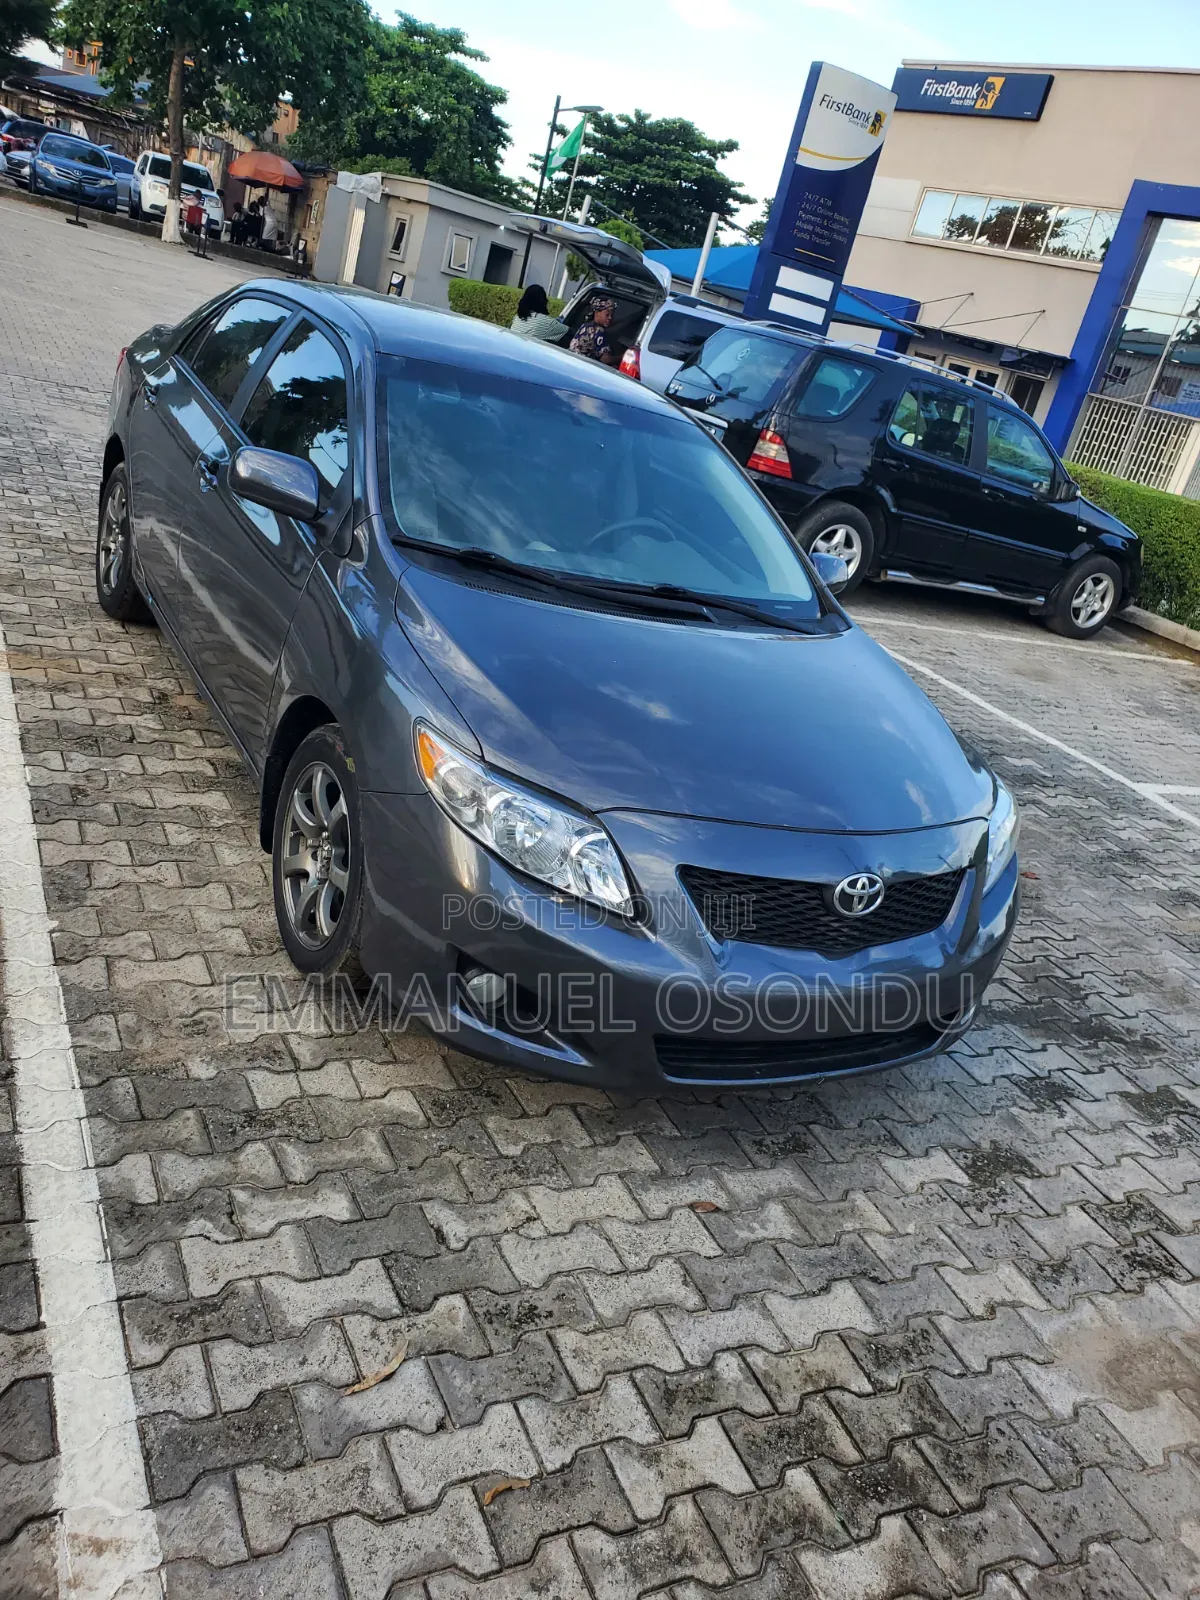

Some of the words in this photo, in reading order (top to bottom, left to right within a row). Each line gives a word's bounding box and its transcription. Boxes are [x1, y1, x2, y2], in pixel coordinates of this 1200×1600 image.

[920, 78, 981, 99] FirstBank
[949, 98, 963, 106] Since
[963, 99, 976, 107] 1894
[819, 94, 872, 125] FirstBank
[848, 118, 859, 127] Since
[804, 192, 819, 202] 24/7
[820, 197, 832, 206] ATM
[801, 202, 816, 212] 24/7
[793, 229, 810, 240] Funds
